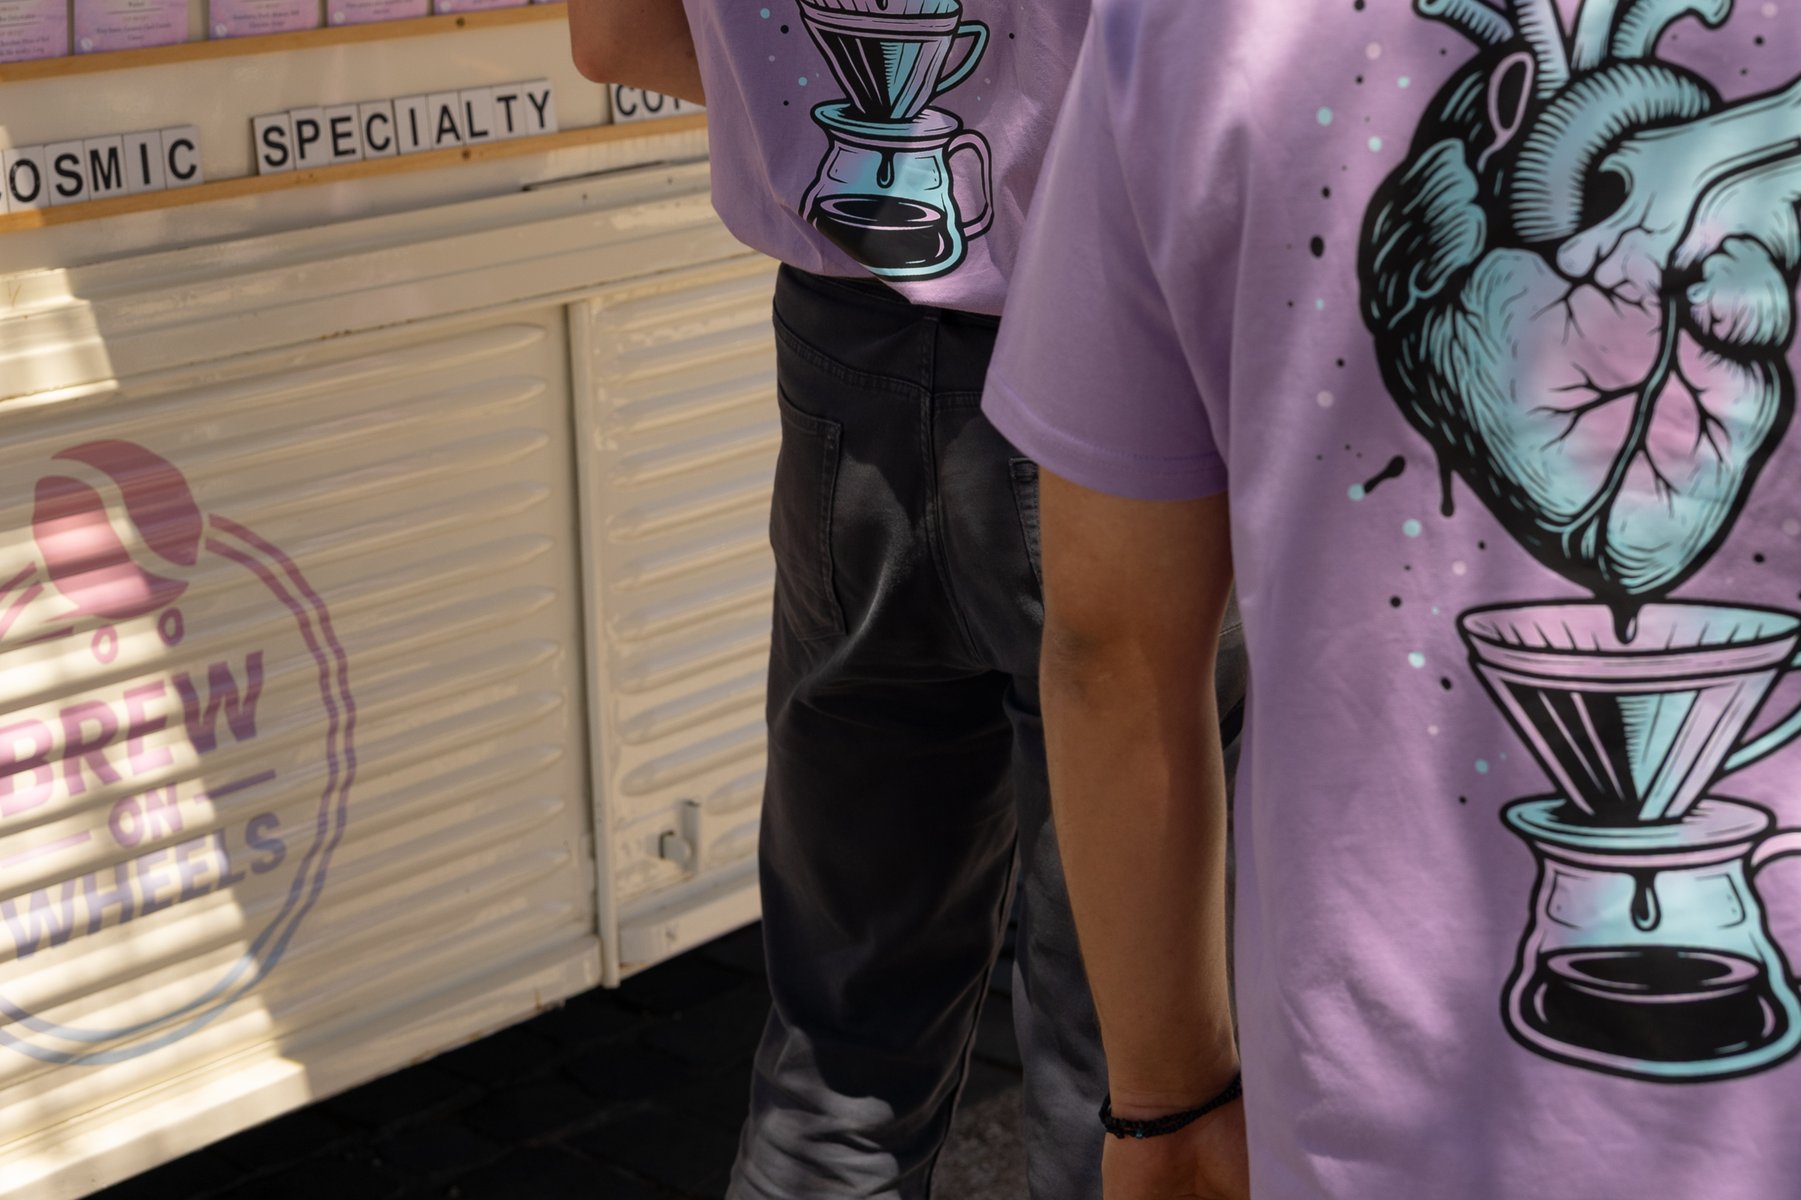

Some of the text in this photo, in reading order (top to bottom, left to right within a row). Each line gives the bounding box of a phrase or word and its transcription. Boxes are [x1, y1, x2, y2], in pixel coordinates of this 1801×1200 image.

[0, 83, 680, 203] OSMIC SPECIALTY CO
[0, 650, 264, 817] BREW
[108, 782, 183, 849] ON
[0, 812, 286, 961] WHEELS
